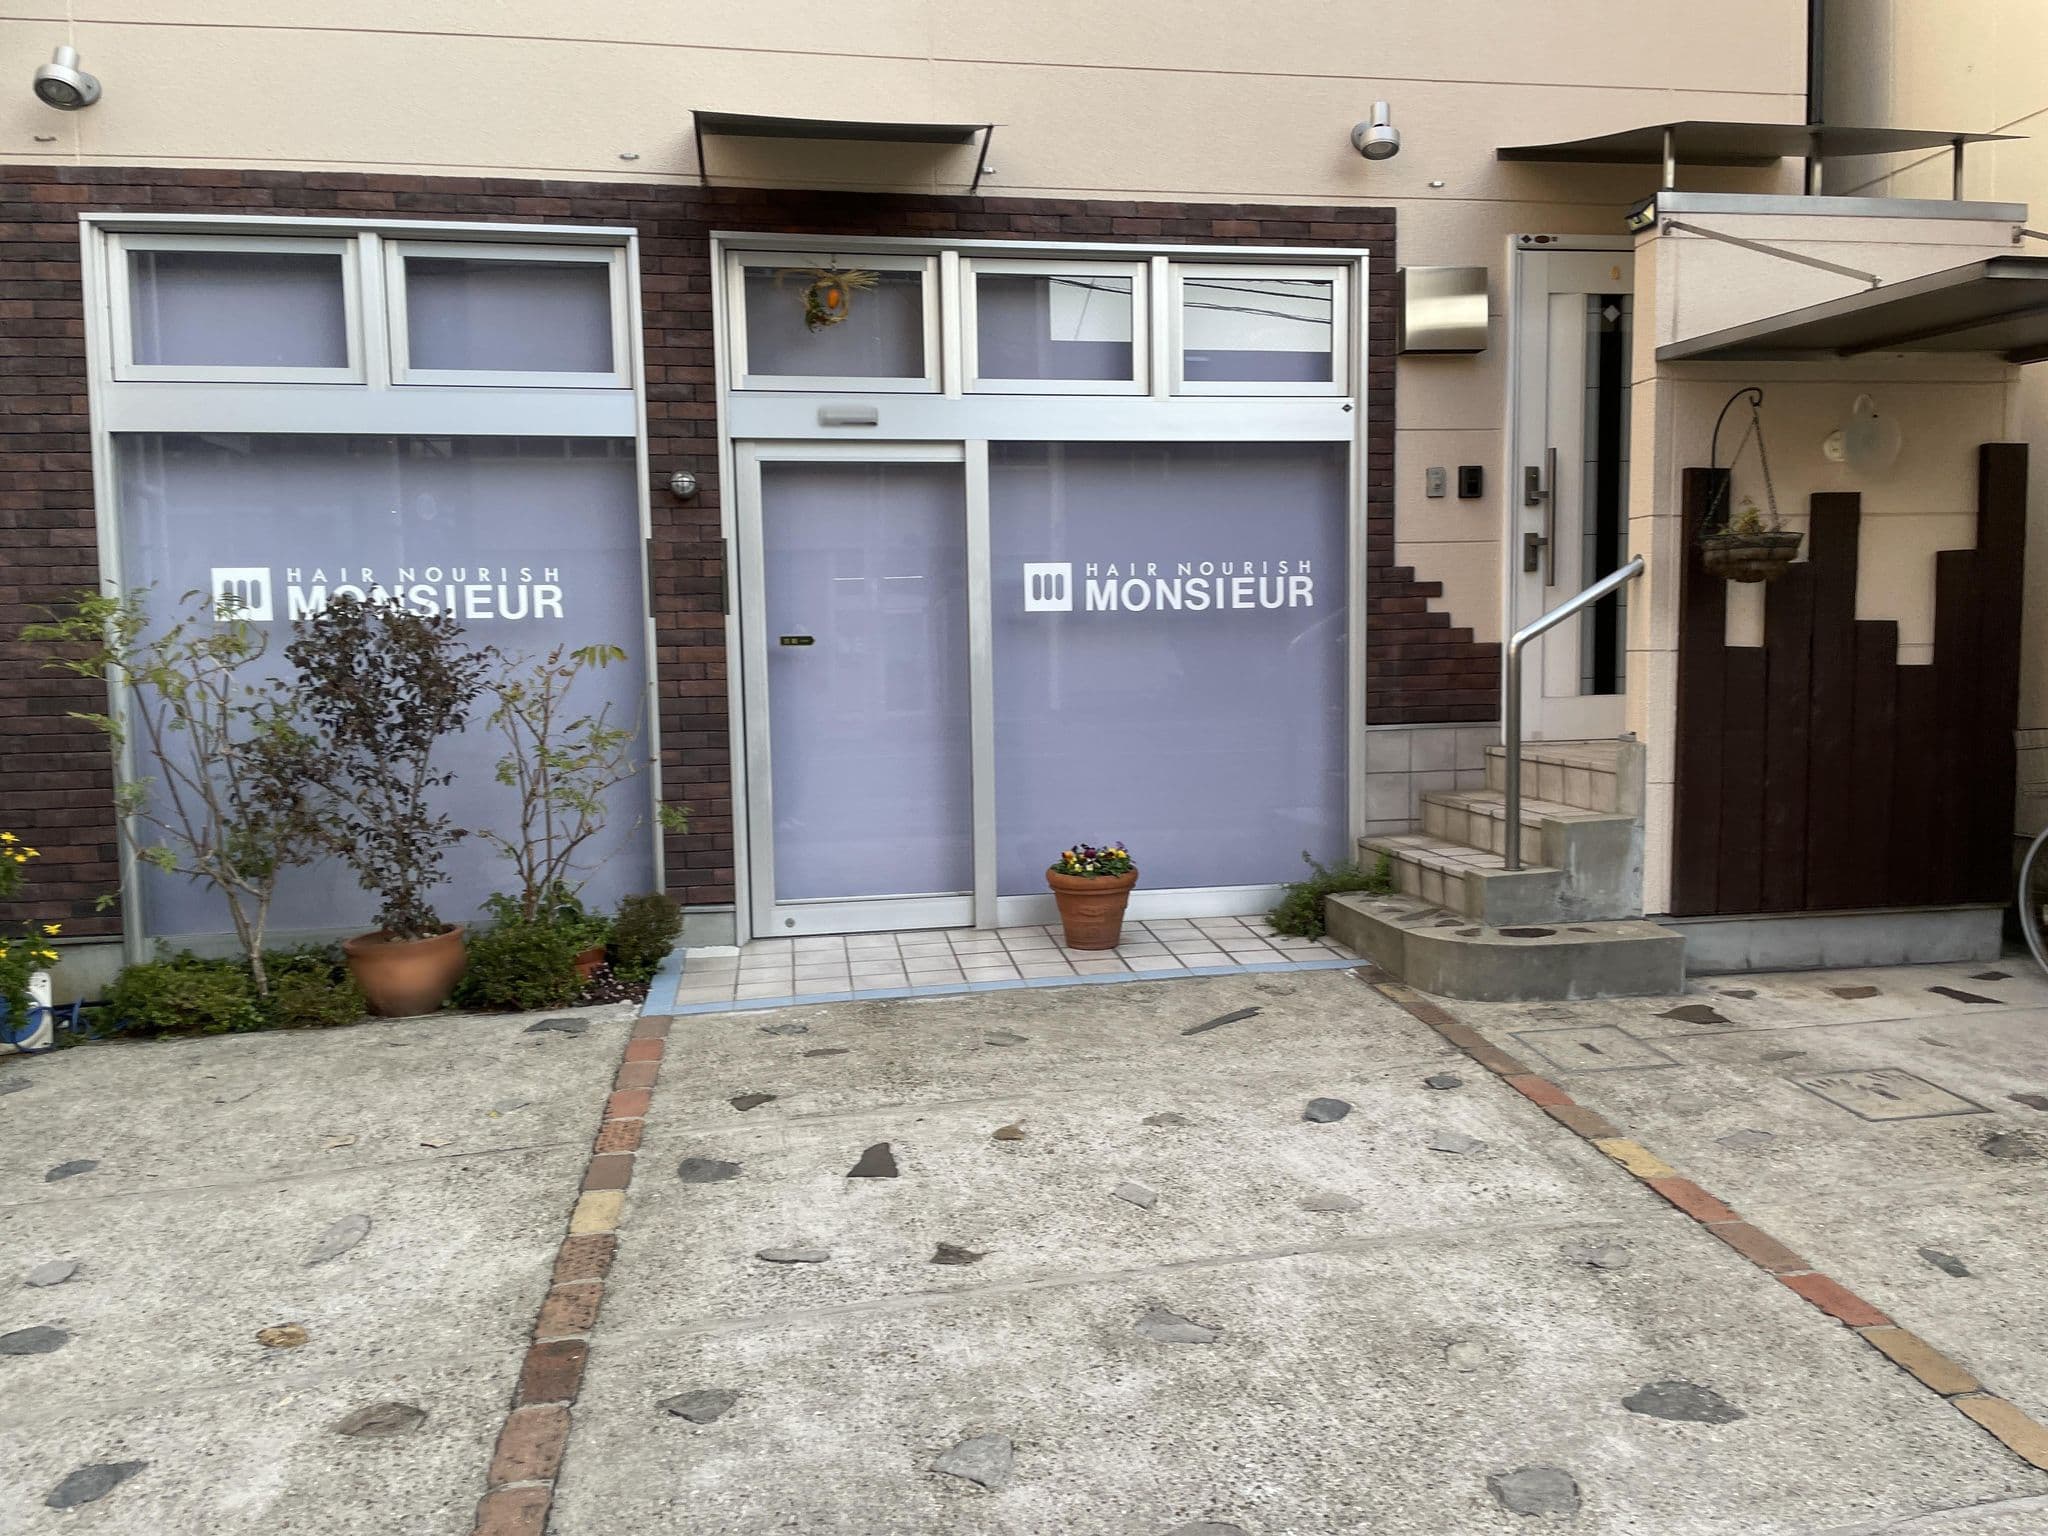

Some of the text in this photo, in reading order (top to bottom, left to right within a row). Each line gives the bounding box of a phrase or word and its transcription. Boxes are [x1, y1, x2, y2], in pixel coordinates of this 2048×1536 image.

[286, 566, 561, 583] HAIR NOURISH
[1086, 560, 1312, 577] HAIR NOURISH
[1085, 575, 1315, 612] MONSIEUR
